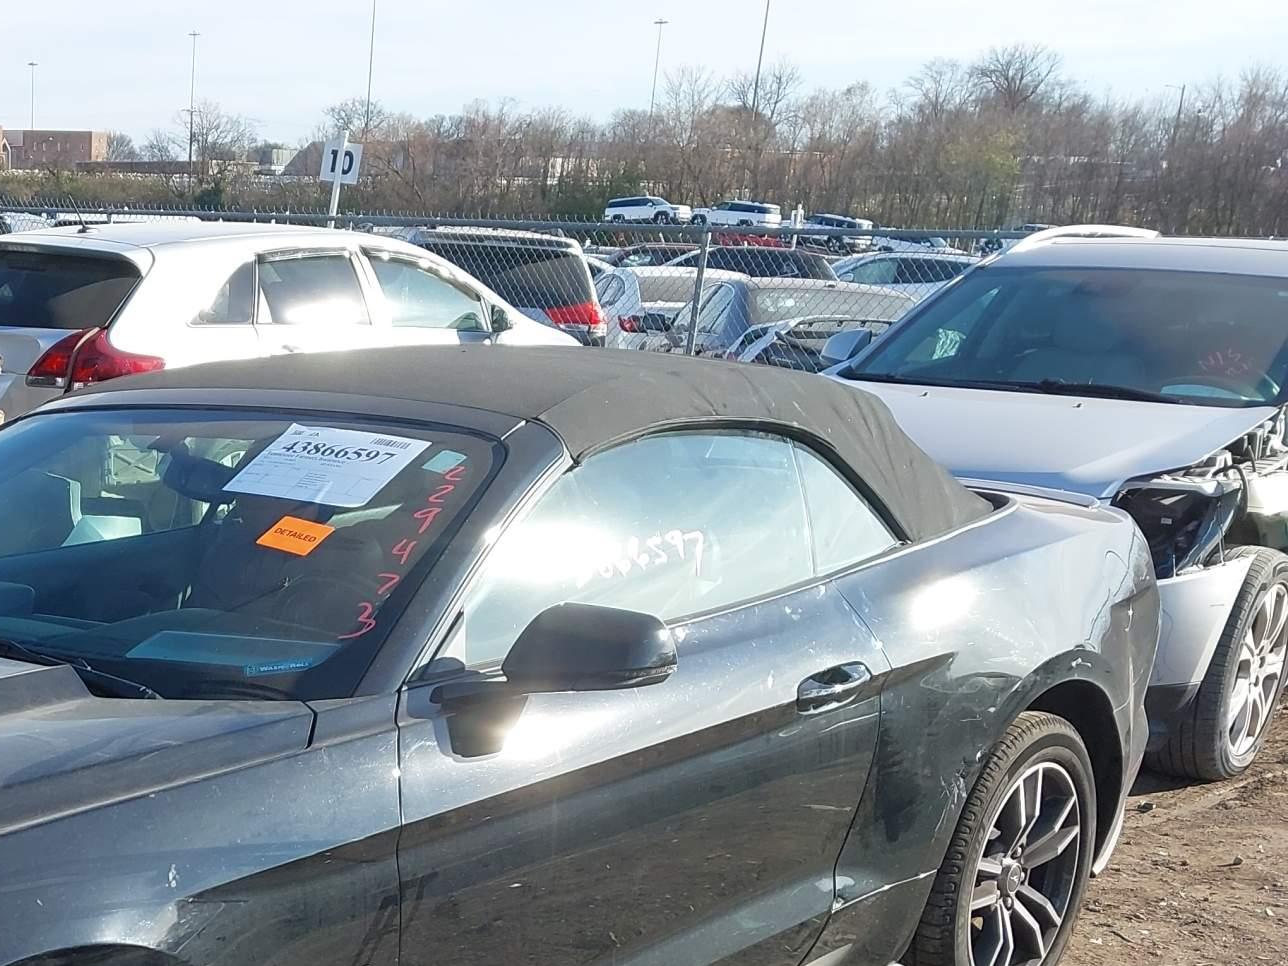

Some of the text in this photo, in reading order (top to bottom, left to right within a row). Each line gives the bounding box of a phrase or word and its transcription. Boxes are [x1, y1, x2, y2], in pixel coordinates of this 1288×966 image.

[329, 148, 355, 176] 10
[281, 440, 399, 465] 43866597
[273, 527, 317, 543] DETAILED
